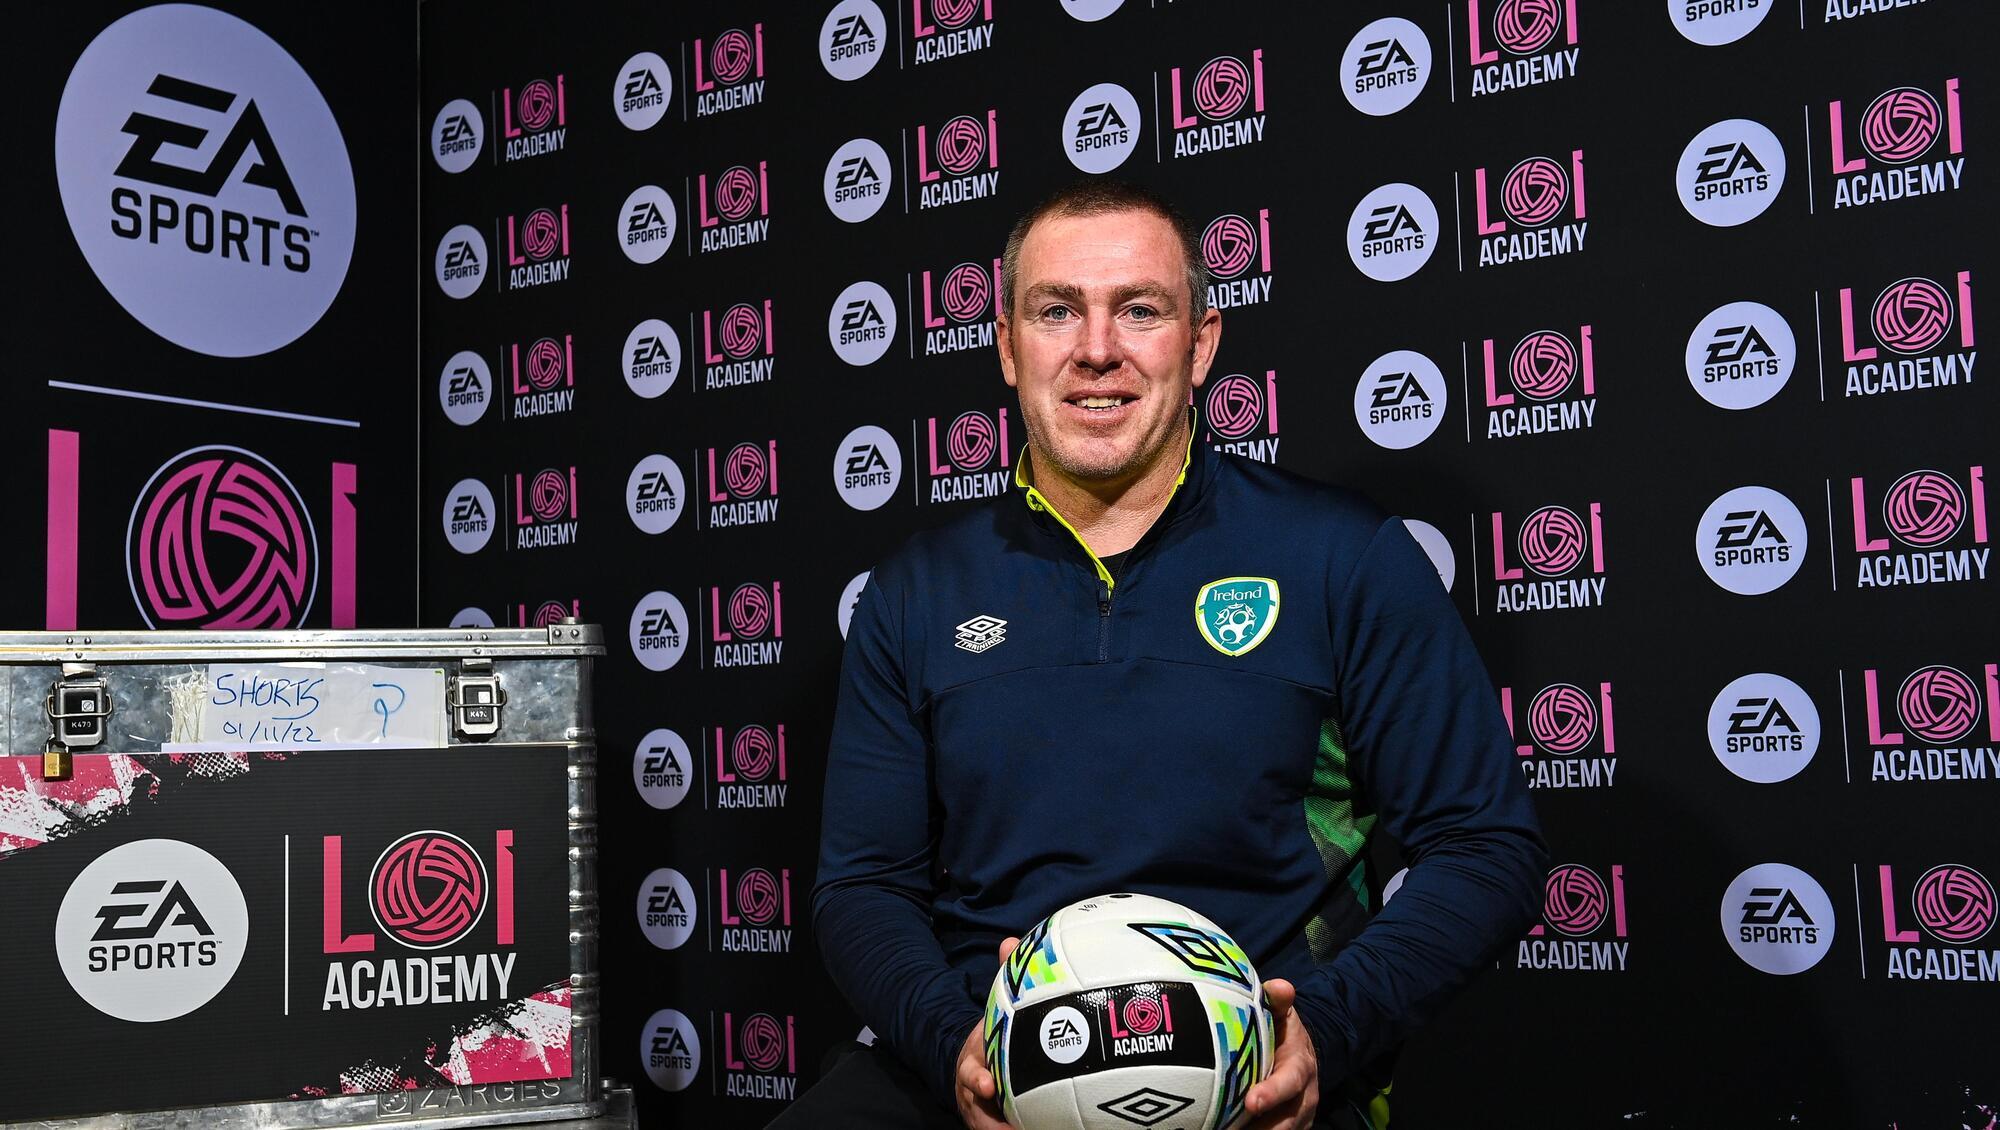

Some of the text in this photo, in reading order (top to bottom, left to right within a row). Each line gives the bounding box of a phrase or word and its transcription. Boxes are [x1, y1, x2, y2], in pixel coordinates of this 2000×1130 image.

[831, 15, 874, 48] EA
[915, 23, 994, 65] ACADEMY
[831, 40, 875, 61] SPORTS
[1356, 39, 1415, 77] EA
[624, 70, 661, 100] EA
[1356, 68, 1416, 93] SPORTS
[1472, 48, 1579, 97] ACADEMY
[623, 93, 662, 112] SPORTS
[697, 80, 765, 117] ACADEMY
[441, 115, 474, 143] EA
[1076, 103, 1126, 138] EA
[114, 74, 308, 218] EA
[440, 138, 475, 156] SPORTS
[506, 129, 566, 161] ACADEMY
[1076, 130, 1127, 153] SPORTS
[1175, 115, 1265, 158] ACADEMY
[836, 157, 879, 189] EA
[1695, 142, 1765, 184] EA
[835, 183, 880, 203] SPORTS
[920, 171, 999, 209] ACADEMY
[1695, 174, 1767, 201] SPORTS
[1835, 158, 1964, 209] ACADEMY
[628, 203, 665, 232] EA
[1363, 205, 1422, 242] EA
[628, 227, 667, 245] SPORTS
[701, 219, 769, 253] ACADEMY
[1363, 235, 1423, 258] SPORTS
[1480, 222, 1587, 267] ACADEMY
[445, 241, 478, 268] EA
[444, 264, 479, 281] SPORTS
[510, 258, 570, 289] ACADEMY
[841, 300, 884, 331] EA
[840, 326, 885, 345] SPORTS
[926, 320, 998, 356] ACADEM
[1705, 325, 1776, 365] EA
[633, 337, 670, 365] EA
[449, 368, 482, 394] EA
[632, 362, 671, 378] SPORTS
[706, 358, 774, 389] ACADEMY
[1704, 359, 1778, 383] SPORTS
[1846, 352, 1976, 397] ACADEMY
[448, 391, 483, 406] SPORTS
[514, 390, 574, 418] ACADEMY
[1371, 372, 1430, 408] EA
[1370, 404, 1431, 424] SPORTS
[1488, 399, 1597, 439] ACADEMY
[846, 445, 889, 475] EA
[637, 472, 674, 500] EA
[845, 472, 891, 489] SPORTS
[930, 471, 1010, 503] ACADEMY
[452, 496, 486, 522] EA
[636, 498, 675, 513] SPORTS
[710, 499, 778, 528] ACADEMY
[452, 520, 487, 534] SPORTS
[518, 522, 578, 550] ACADEMY
[1715, 510, 1787, 548] EA
[1715, 546, 1789, 567] SPORTS
[1858, 548, 1990, 588] ACADEMY
[1213, 586, 1263, 602] Ireland
[1497, 577, 1606, 612] ACADEMY
[640, 609, 678, 636] EA
[640, 635, 679, 650] SPORTS
[714, 641, 782, 667] ACADEMY
[212, 674, 324, 720] SHORTS
[1727, 698, 1800, 734] EA
[1727, 735, 1802, 753] SPORTS
[643, 747, 681, 774] EA
[643, 774, 683, 788] SPORTS
[718, 785, 787, 808] ACADEMY
[90, 880, 214, 942] EA
[647, 886, 685, 913] EA
[1740, 888, 1814, 925] EA
[647, 914, 686, 927] SPORTS
[723, 929, 792, 953] ACADEMY
[1740, 926, 1817, 944] SPORTS
[88, 941, 217, 973] SPORTS
[1517, 940, 1629, 970] ACADEMY
[1888, 948, 2000, 982] ACADEM
[323, 953, 517, 1011] ACADEMY
[651, 1027, 690, 1055] EA
[1048, 1019, 1080, 1040] EA
[1048, 1035, 1082, 1050] SPORTS
[1114, 1033, 1174, 1057] ACADEMY
[651, 1055, 691, 1069] SPORTS
[727, 1074, 797, 1100] ACADEMY
